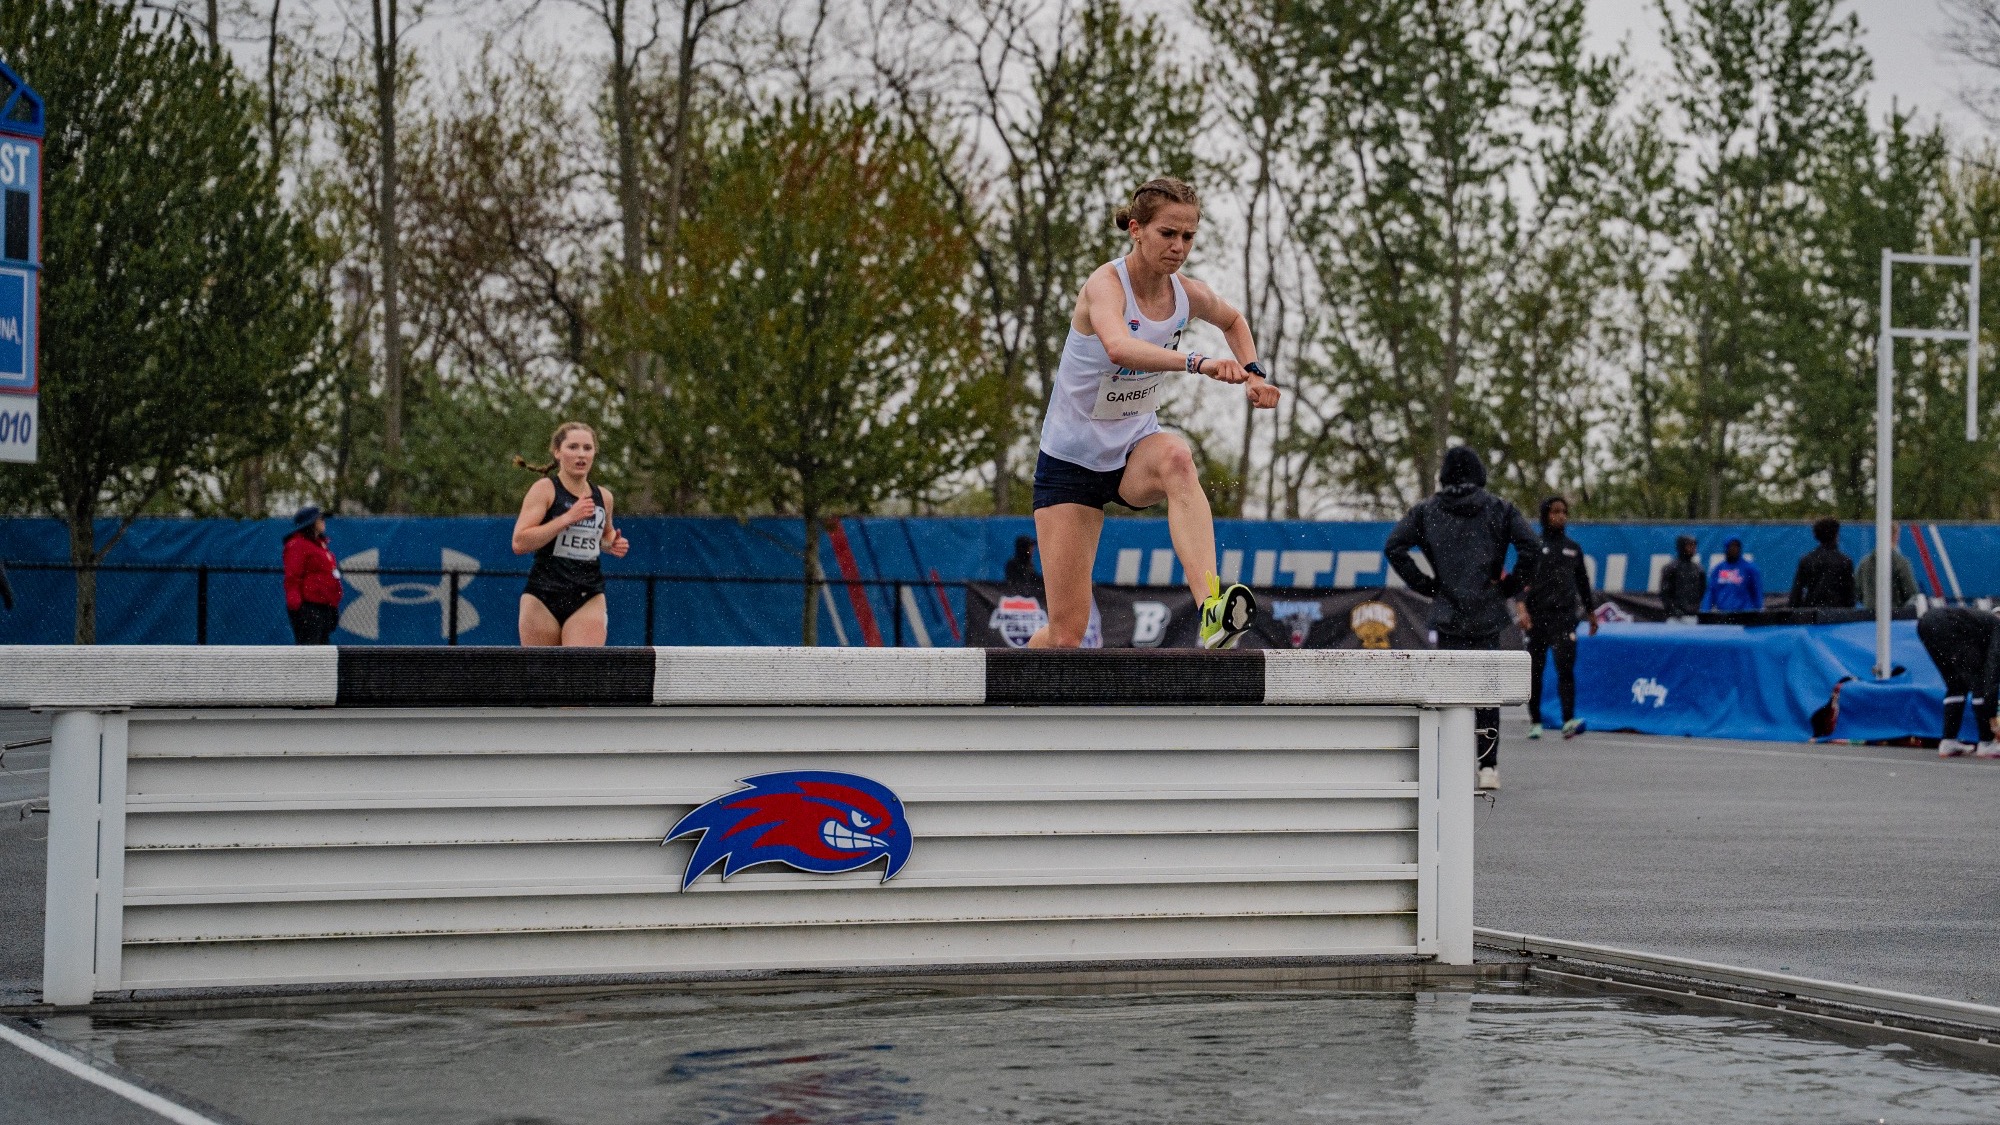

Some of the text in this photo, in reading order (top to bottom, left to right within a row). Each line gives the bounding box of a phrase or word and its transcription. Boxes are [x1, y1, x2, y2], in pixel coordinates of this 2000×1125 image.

[0, 142, 30, 186] ST
[1106, 383, 1158, 402] GARBETT
[0, 410, 31, 443] 010
[561, 534, 596, 550] LEES
